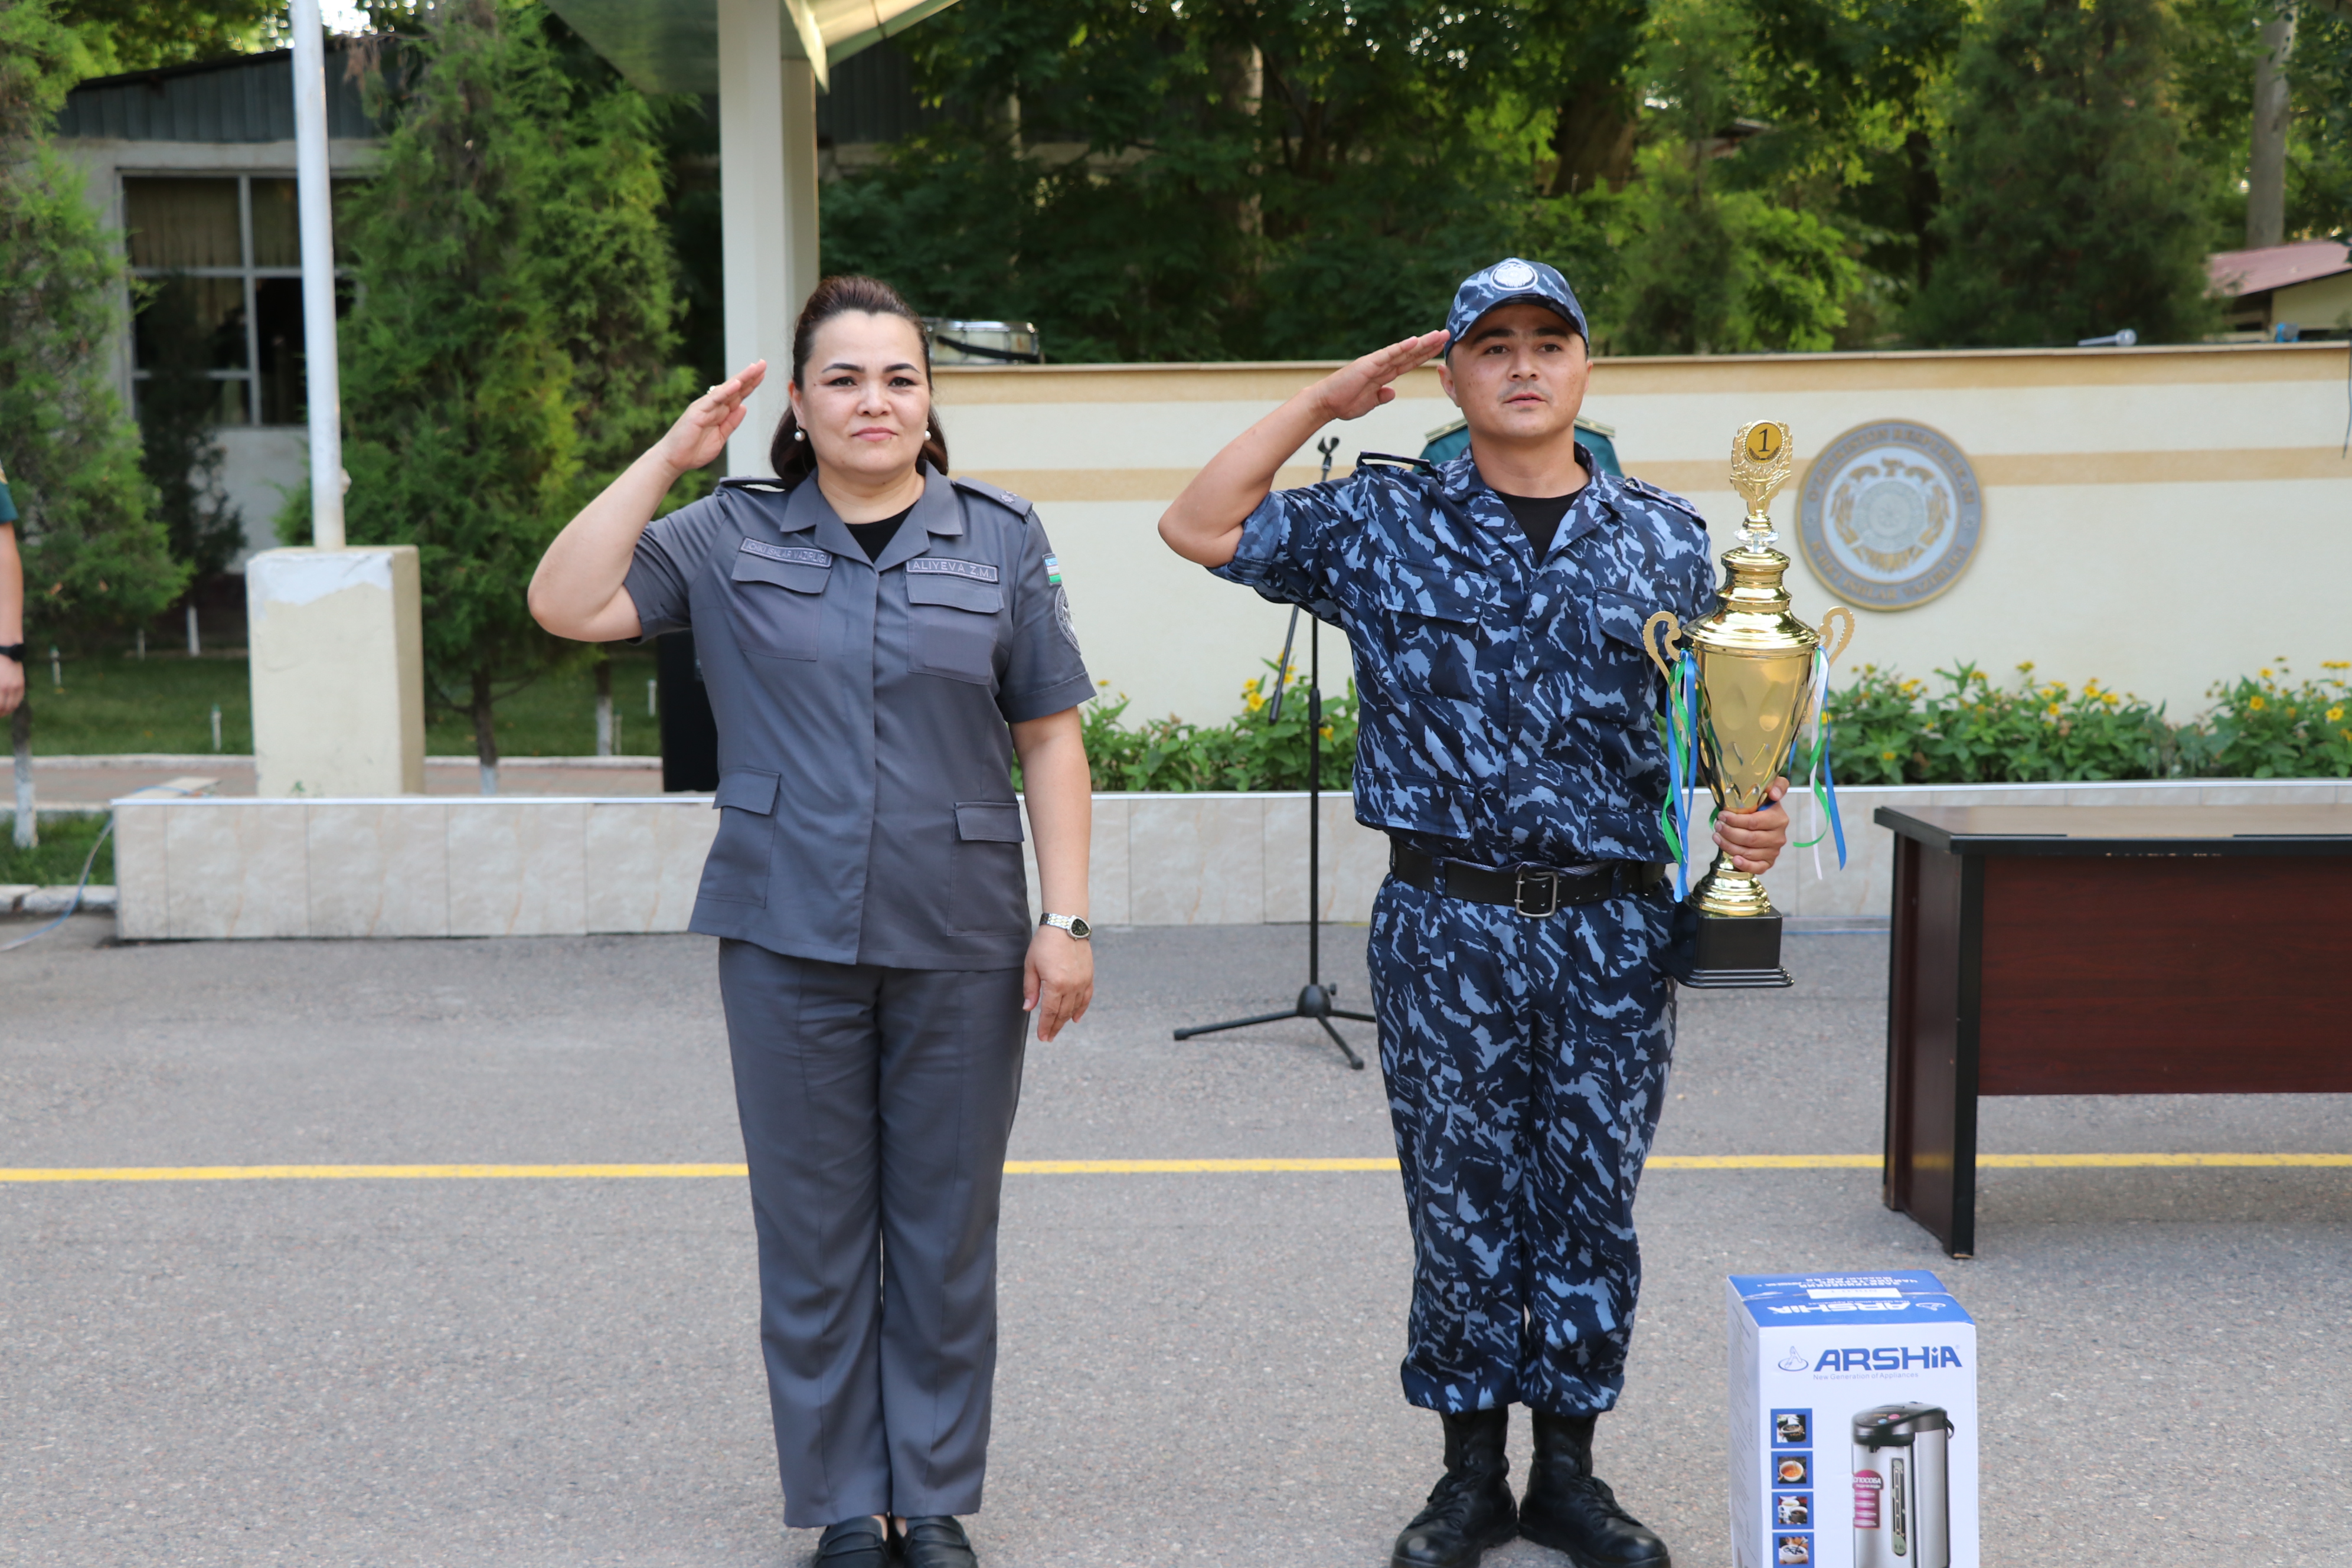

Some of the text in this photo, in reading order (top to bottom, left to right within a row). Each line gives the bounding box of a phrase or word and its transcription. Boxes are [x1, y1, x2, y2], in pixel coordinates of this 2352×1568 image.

[1758, 428, 1770, 452] 1
[746, 542, 827, 564] ICHKI ISHLAR VAZIRLIGI
[912, 561, 992, 579] ALIYEVA Z.M.
